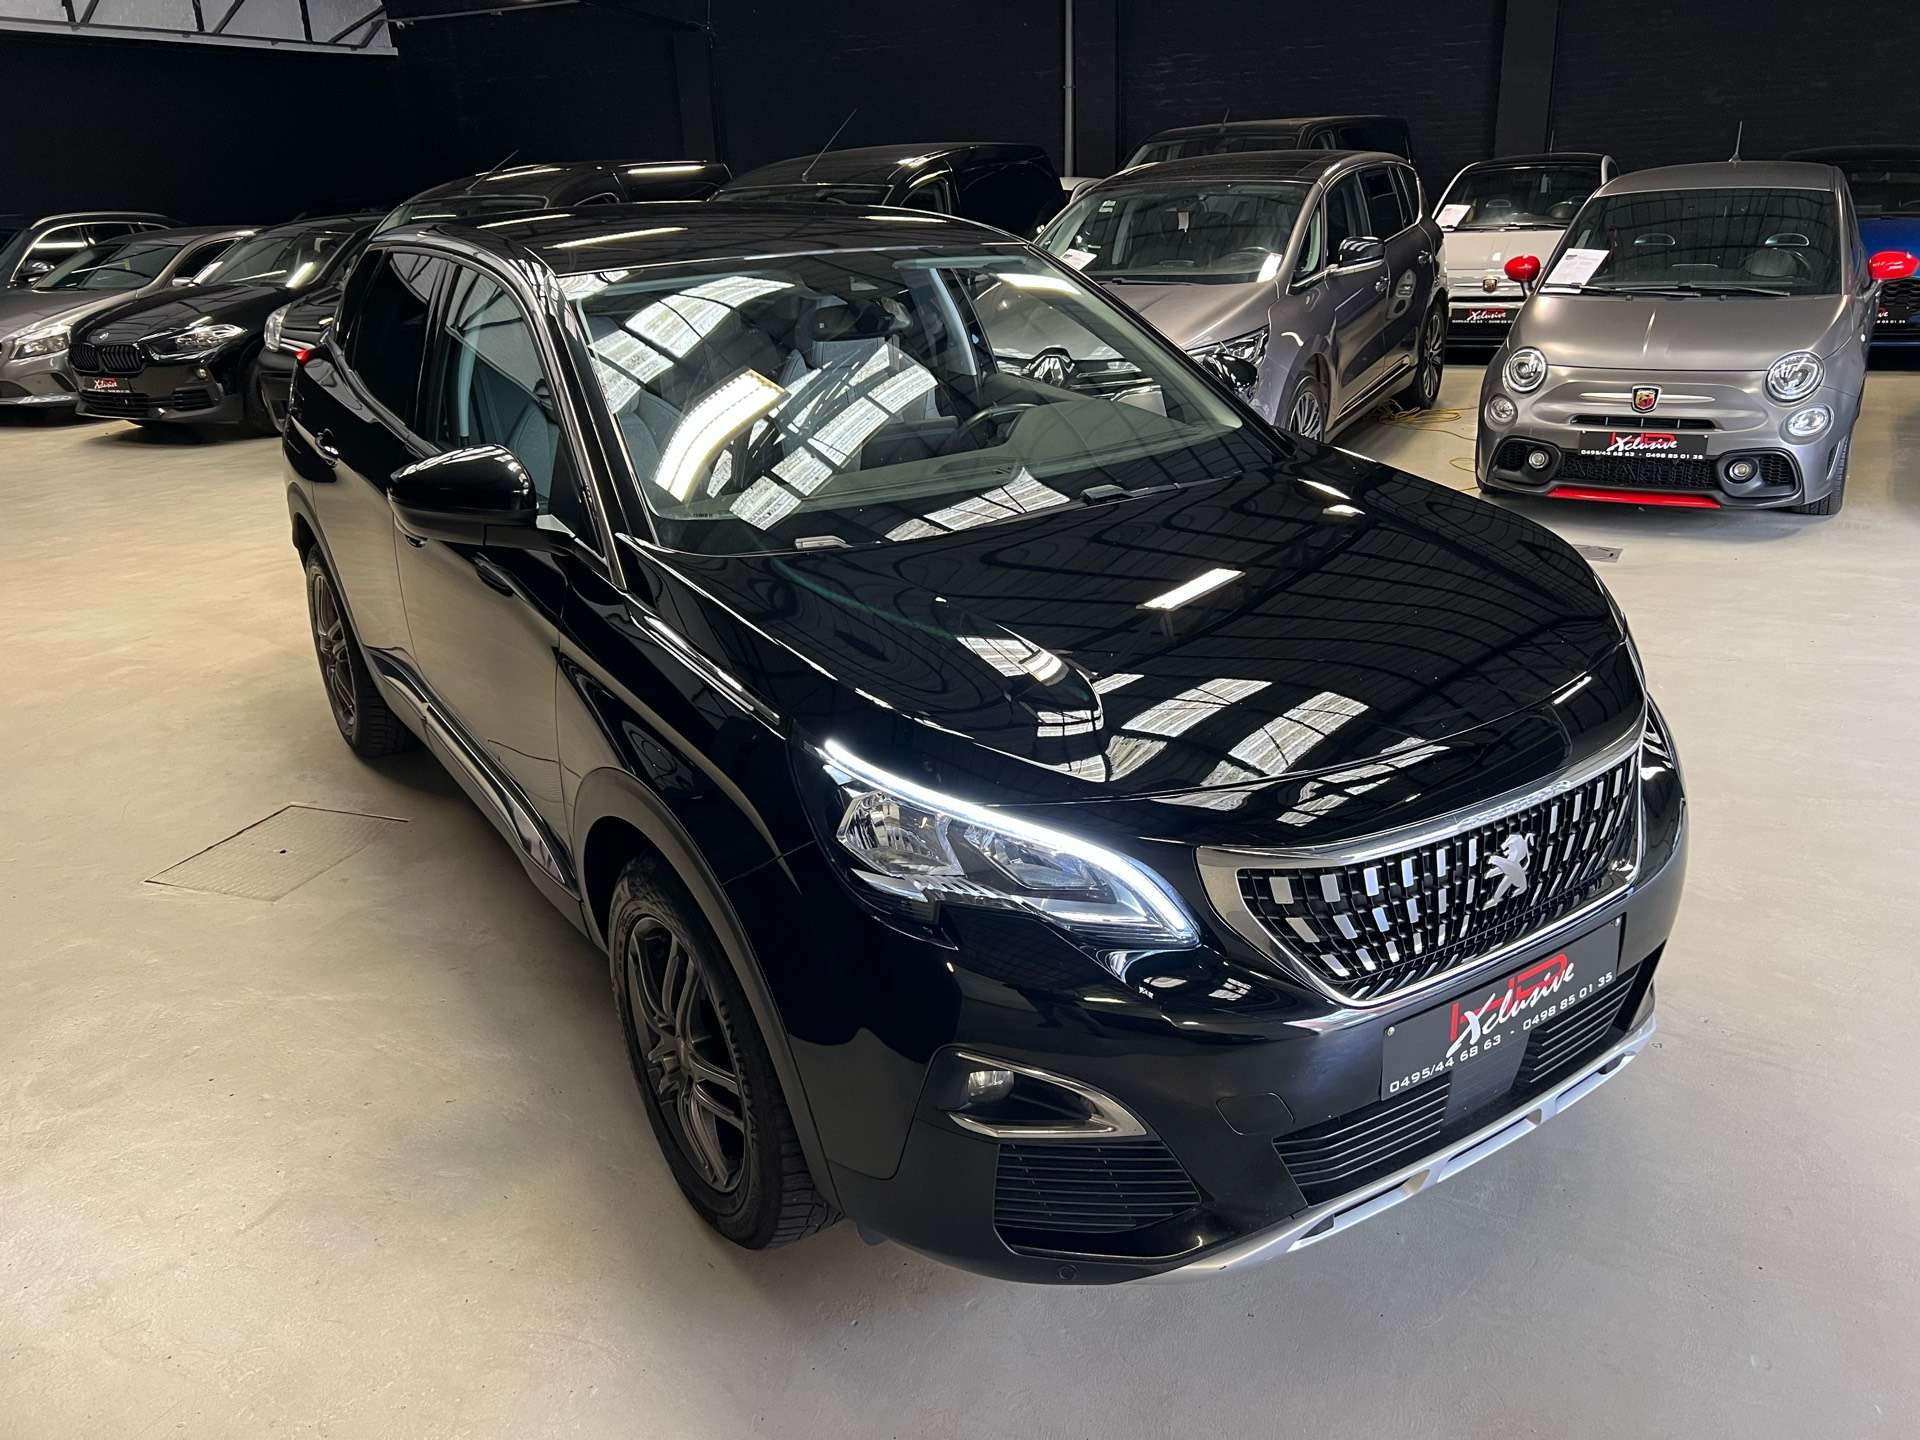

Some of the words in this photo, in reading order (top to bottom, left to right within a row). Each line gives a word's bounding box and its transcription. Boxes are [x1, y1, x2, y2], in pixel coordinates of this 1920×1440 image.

[1606, 435, 1677, 451] Xclusive
[1390, 1057, 1454, 1092] 0495/44
[1460, 1045, 1478, 1061] 68
[1483, 1034, 1501, 1050] 63
[1523, 1005, 1557, 1030] 0498
[1560, 994, 1576, 1010] 85
[1579, 983, 1593, 999] 01
[1598, 971, 1614, 988] 35
[1446, 962, 1574, 1058] Xclusive
